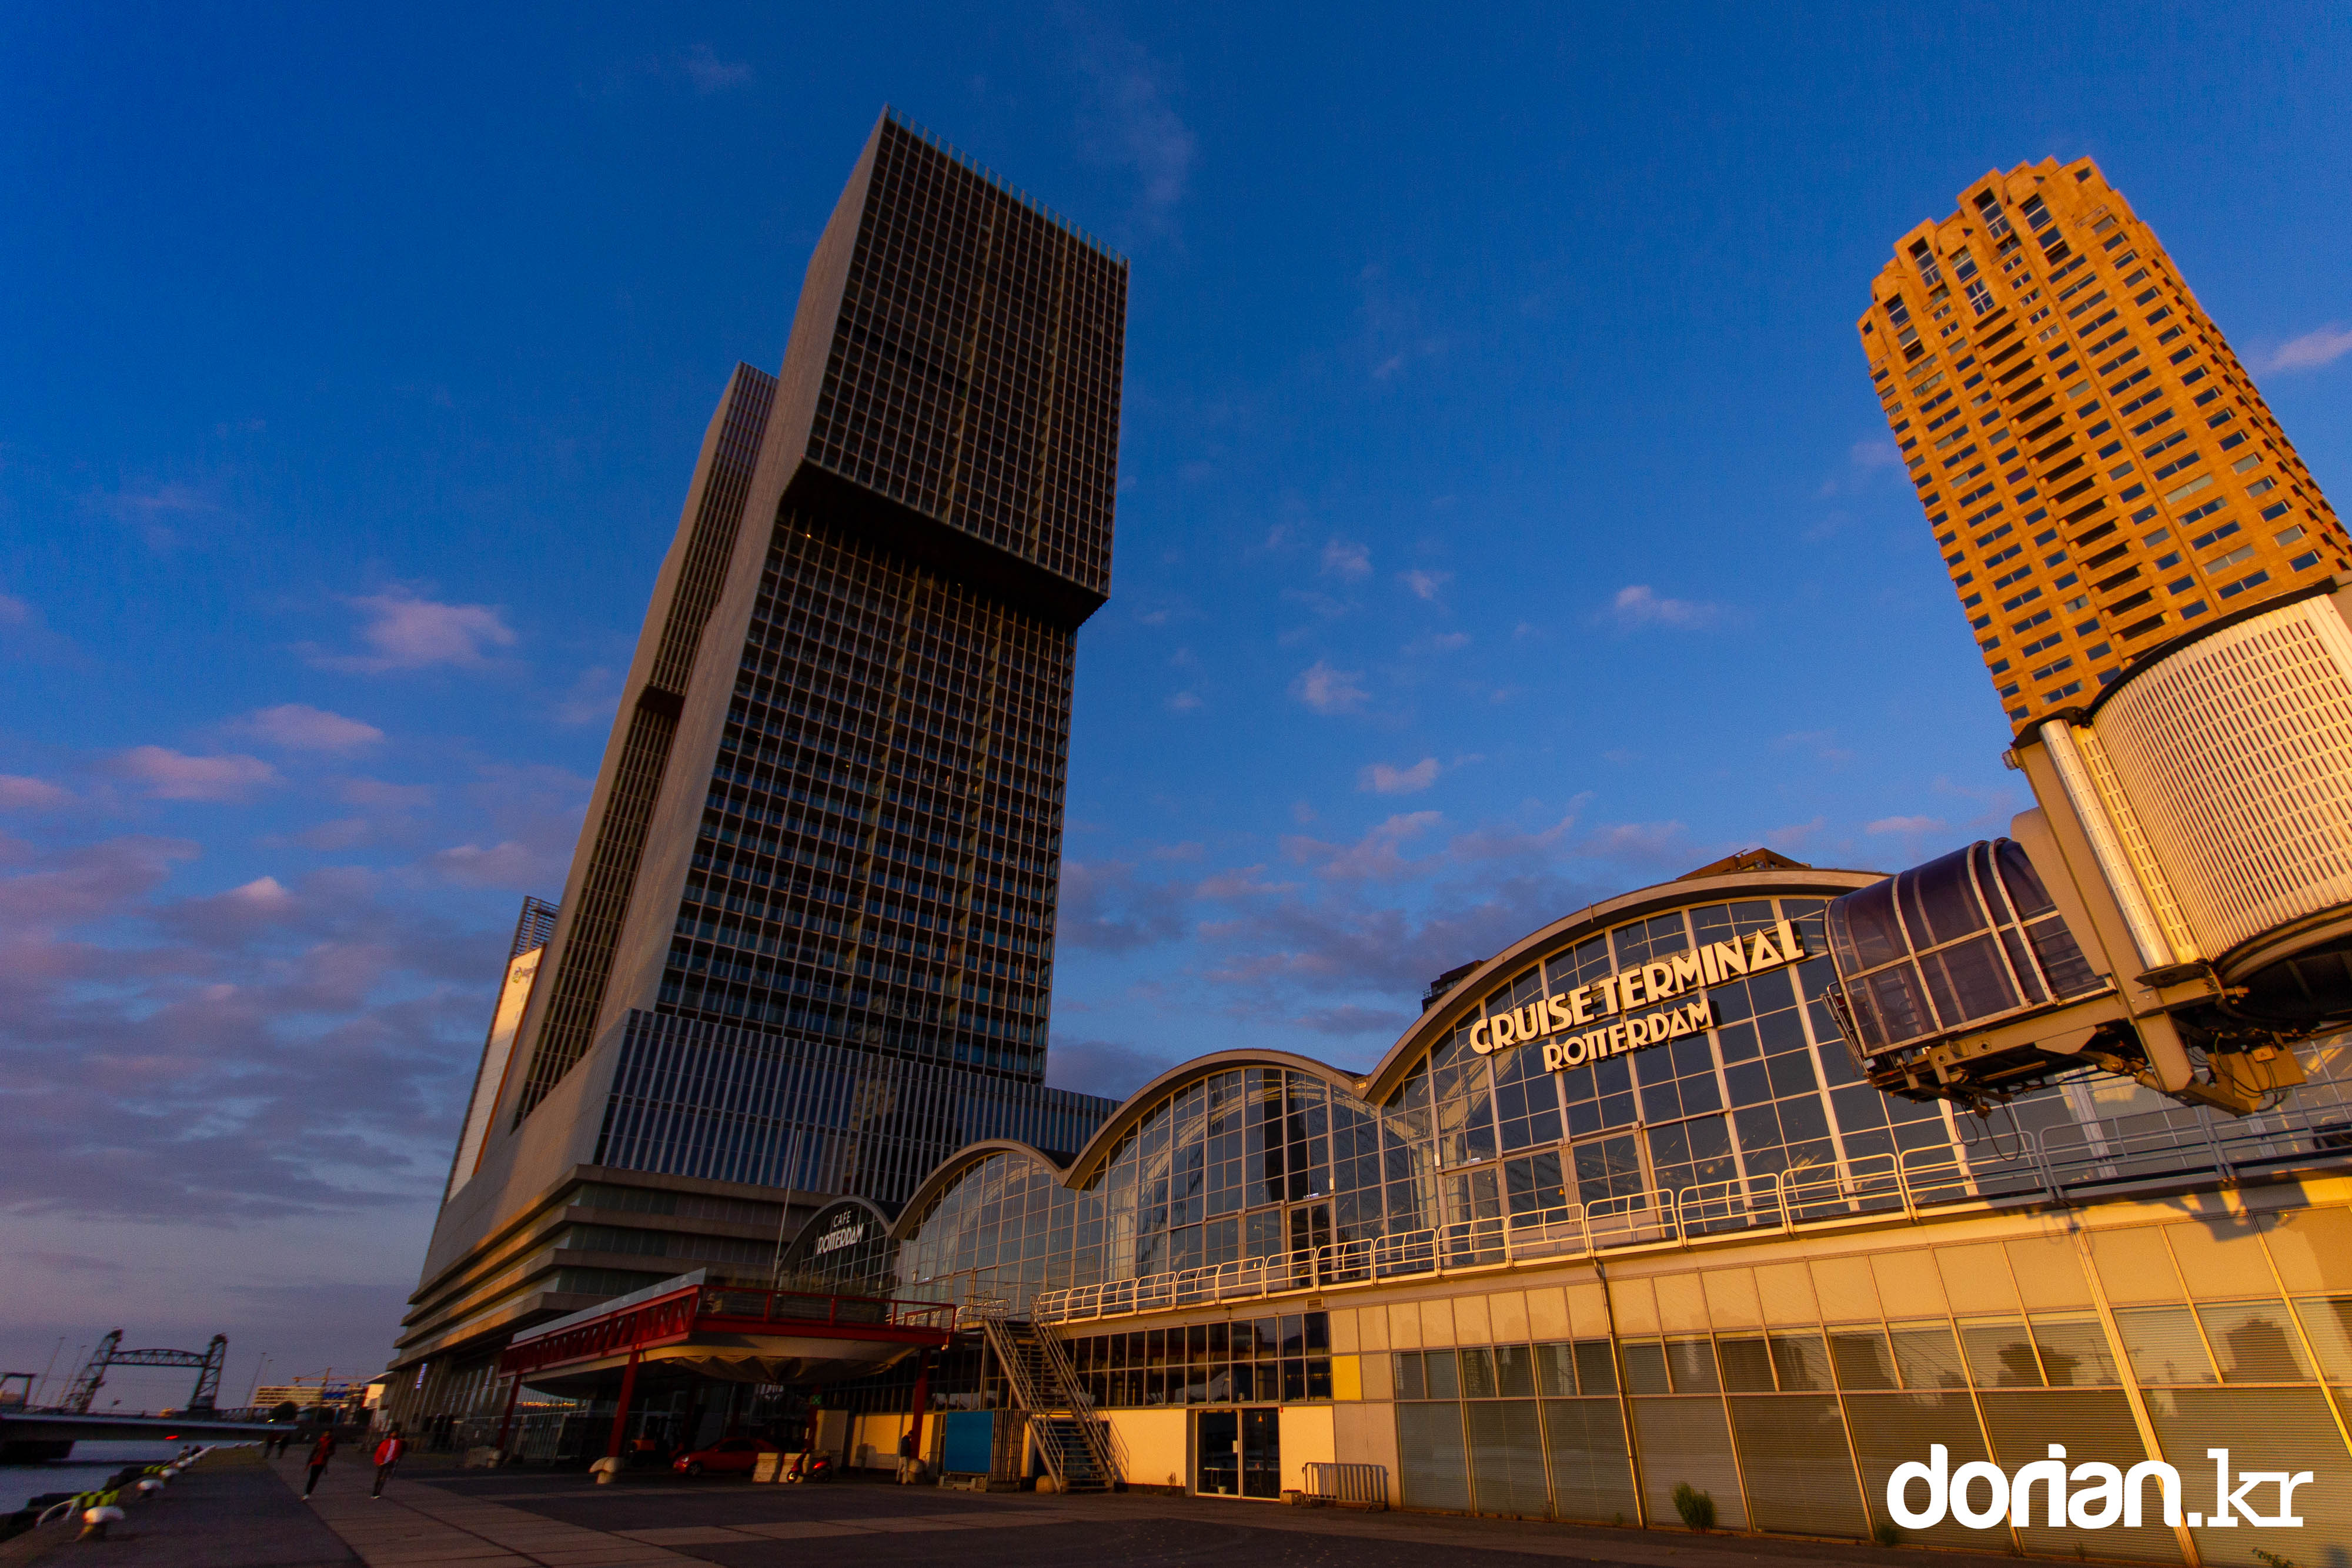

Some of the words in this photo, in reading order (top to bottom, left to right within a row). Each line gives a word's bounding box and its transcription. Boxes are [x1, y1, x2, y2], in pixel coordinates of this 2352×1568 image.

[1469, 985, 1595, 1054] CRUISE
[1598, 919, 1805, 1015] TERMINAL
[1542, 998, 1713, 1072] ROTTERDAM
[816, 1222, 864, 1255] ROTTERDAM
